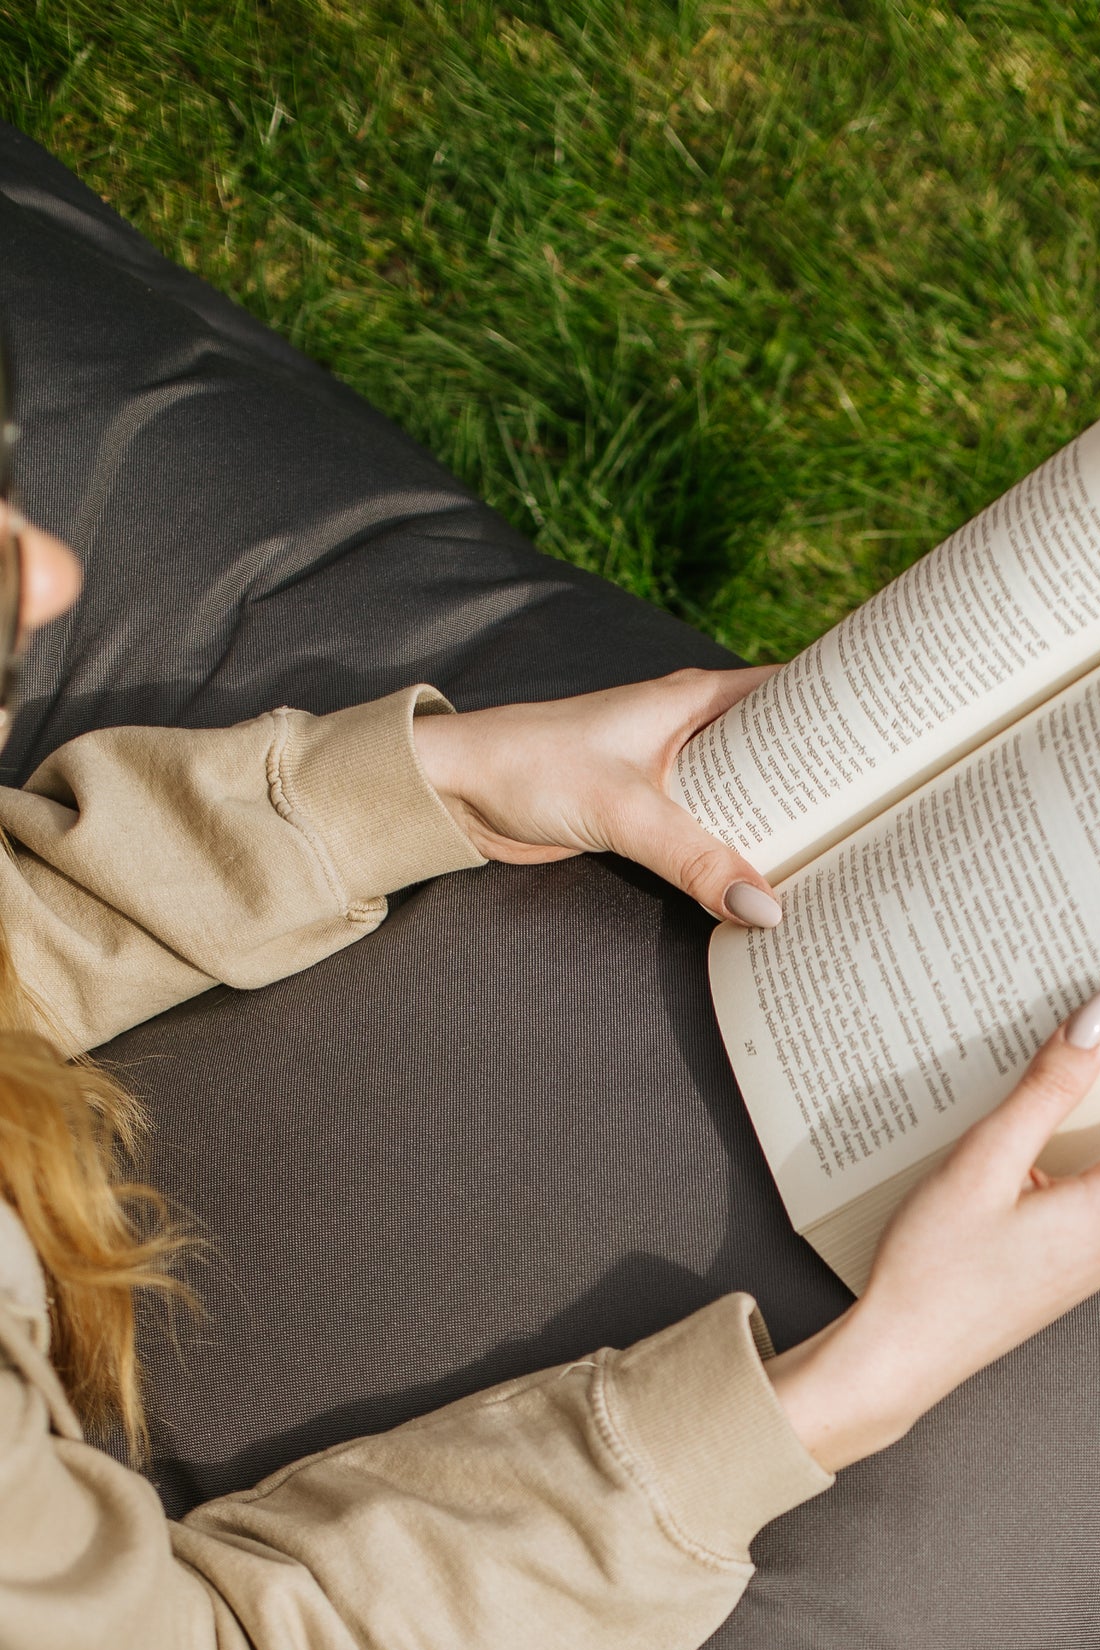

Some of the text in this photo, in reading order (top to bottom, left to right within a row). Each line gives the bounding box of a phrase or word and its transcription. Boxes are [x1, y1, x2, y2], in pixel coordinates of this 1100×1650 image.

[771, 737, 789, 763] przez
[803, 735, 824, 768] bogata
[745, 736, 773, 784] wymieniali
[777, 797, 797, 821] różne
[767, 754, 796, 795] uprawiali
[793, 796, 808, 814] tam
[790, 742, 831, 798] umiarkowane
[693, 778, 721, 827] mieszkańcy
[733, 773, 754, 806] krańcu
[713, 793, 737, 828] siedziby
[745, 820, 764, 844] ubita
[744, 1039, 758, 1056] 247
